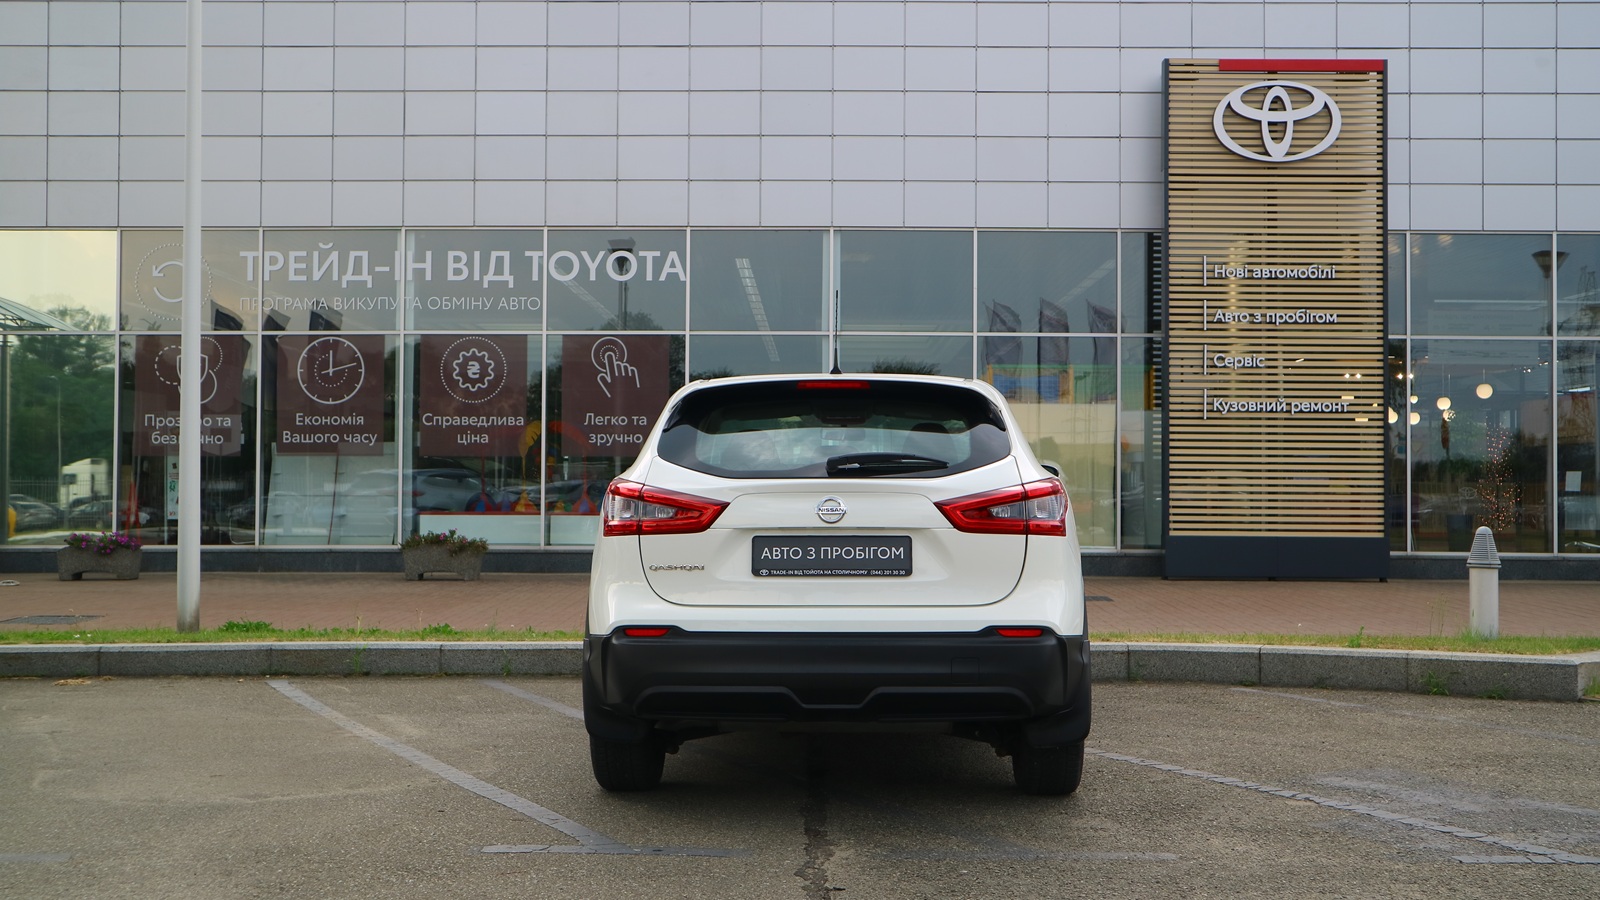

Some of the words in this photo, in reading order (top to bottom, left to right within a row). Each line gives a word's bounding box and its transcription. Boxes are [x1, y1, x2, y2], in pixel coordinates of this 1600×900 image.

[239, 242, 431, 288] ТРЕЙД-ІН
[447, 250, 514, 288] ВІД
[524, 250, 686, 282] TOYOTA
[1214, 264, 1248, 278] Нові
[1252, 265, 1336, 278] автомобілі
[240, 297, 328, 310] ПРОГРАМА
[334, 297, 400, 310] ВИКУПУ
[404, 296, 422, 310] ТА
[428, 296, 494, 310] ОБМІНУ
[498, 296, 541, 310] АВТО
[1214, 310, 1250, 323] Авто
[1253, 312, 1262, 323] з
[1266, 309, 1338, 326] пробігом
[1214, 354, 1266, 370] Сервіс
[1213, 398, 1286, 414] Кузовний
[1291, 400, 1350, 415] ремонт
[144, 414, 212, 429] Прозо
[216, 417, 232, 427] та
[295, 412, 364, 426] Економія
[422, 413, 524, 427] Справедлива
[584, 412, 628, 426] Легко
[632, 416, 648, 426] та
[282, 432, 340, 444] Вашого
[344, 433, 378, 446] часу
[457, 432, 489, 444] ціна
[588, 433, 643, 446] зручно
[760, 546, 802, 560] АВТО
[806, 546, 816, 560] З
[820, 546, 904, 560] ПРОБІГОМ
